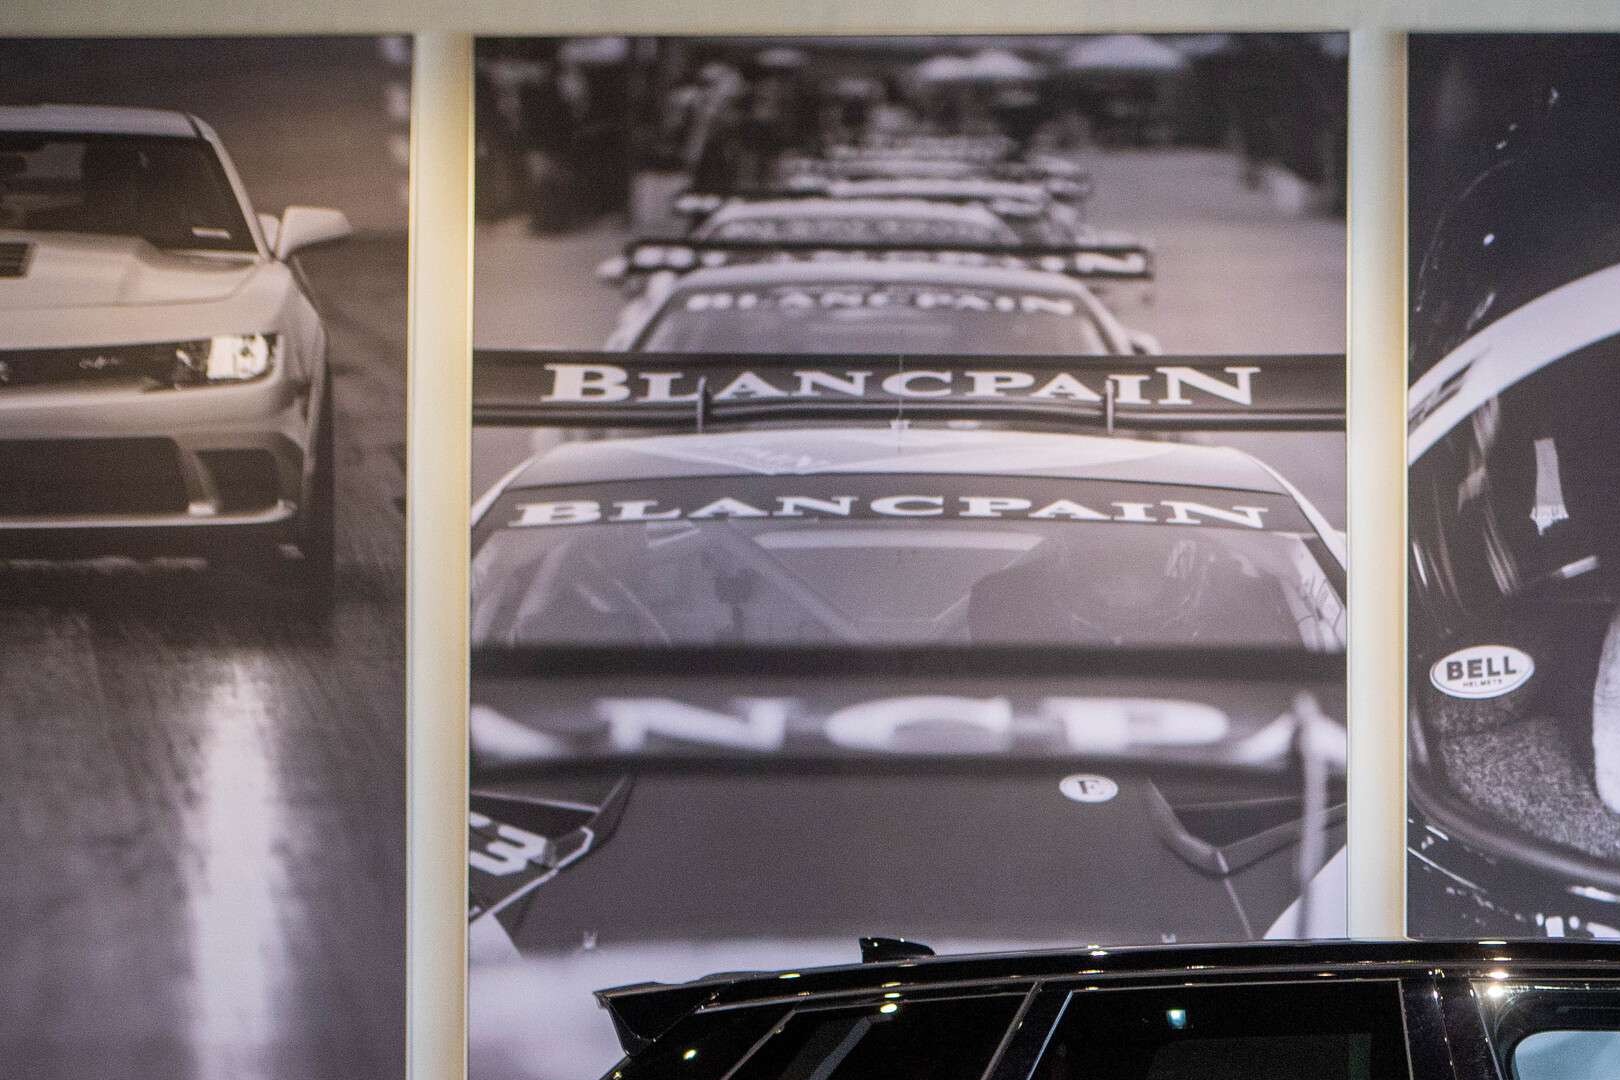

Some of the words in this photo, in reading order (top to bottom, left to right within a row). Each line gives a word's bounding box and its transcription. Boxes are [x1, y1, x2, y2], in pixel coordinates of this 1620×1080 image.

[541, 362, 1262, 406] BLANCPAIN
[509, 495, 1269, 529] BLANCPAIN
[1446, 655, 1517, 681] BELL
